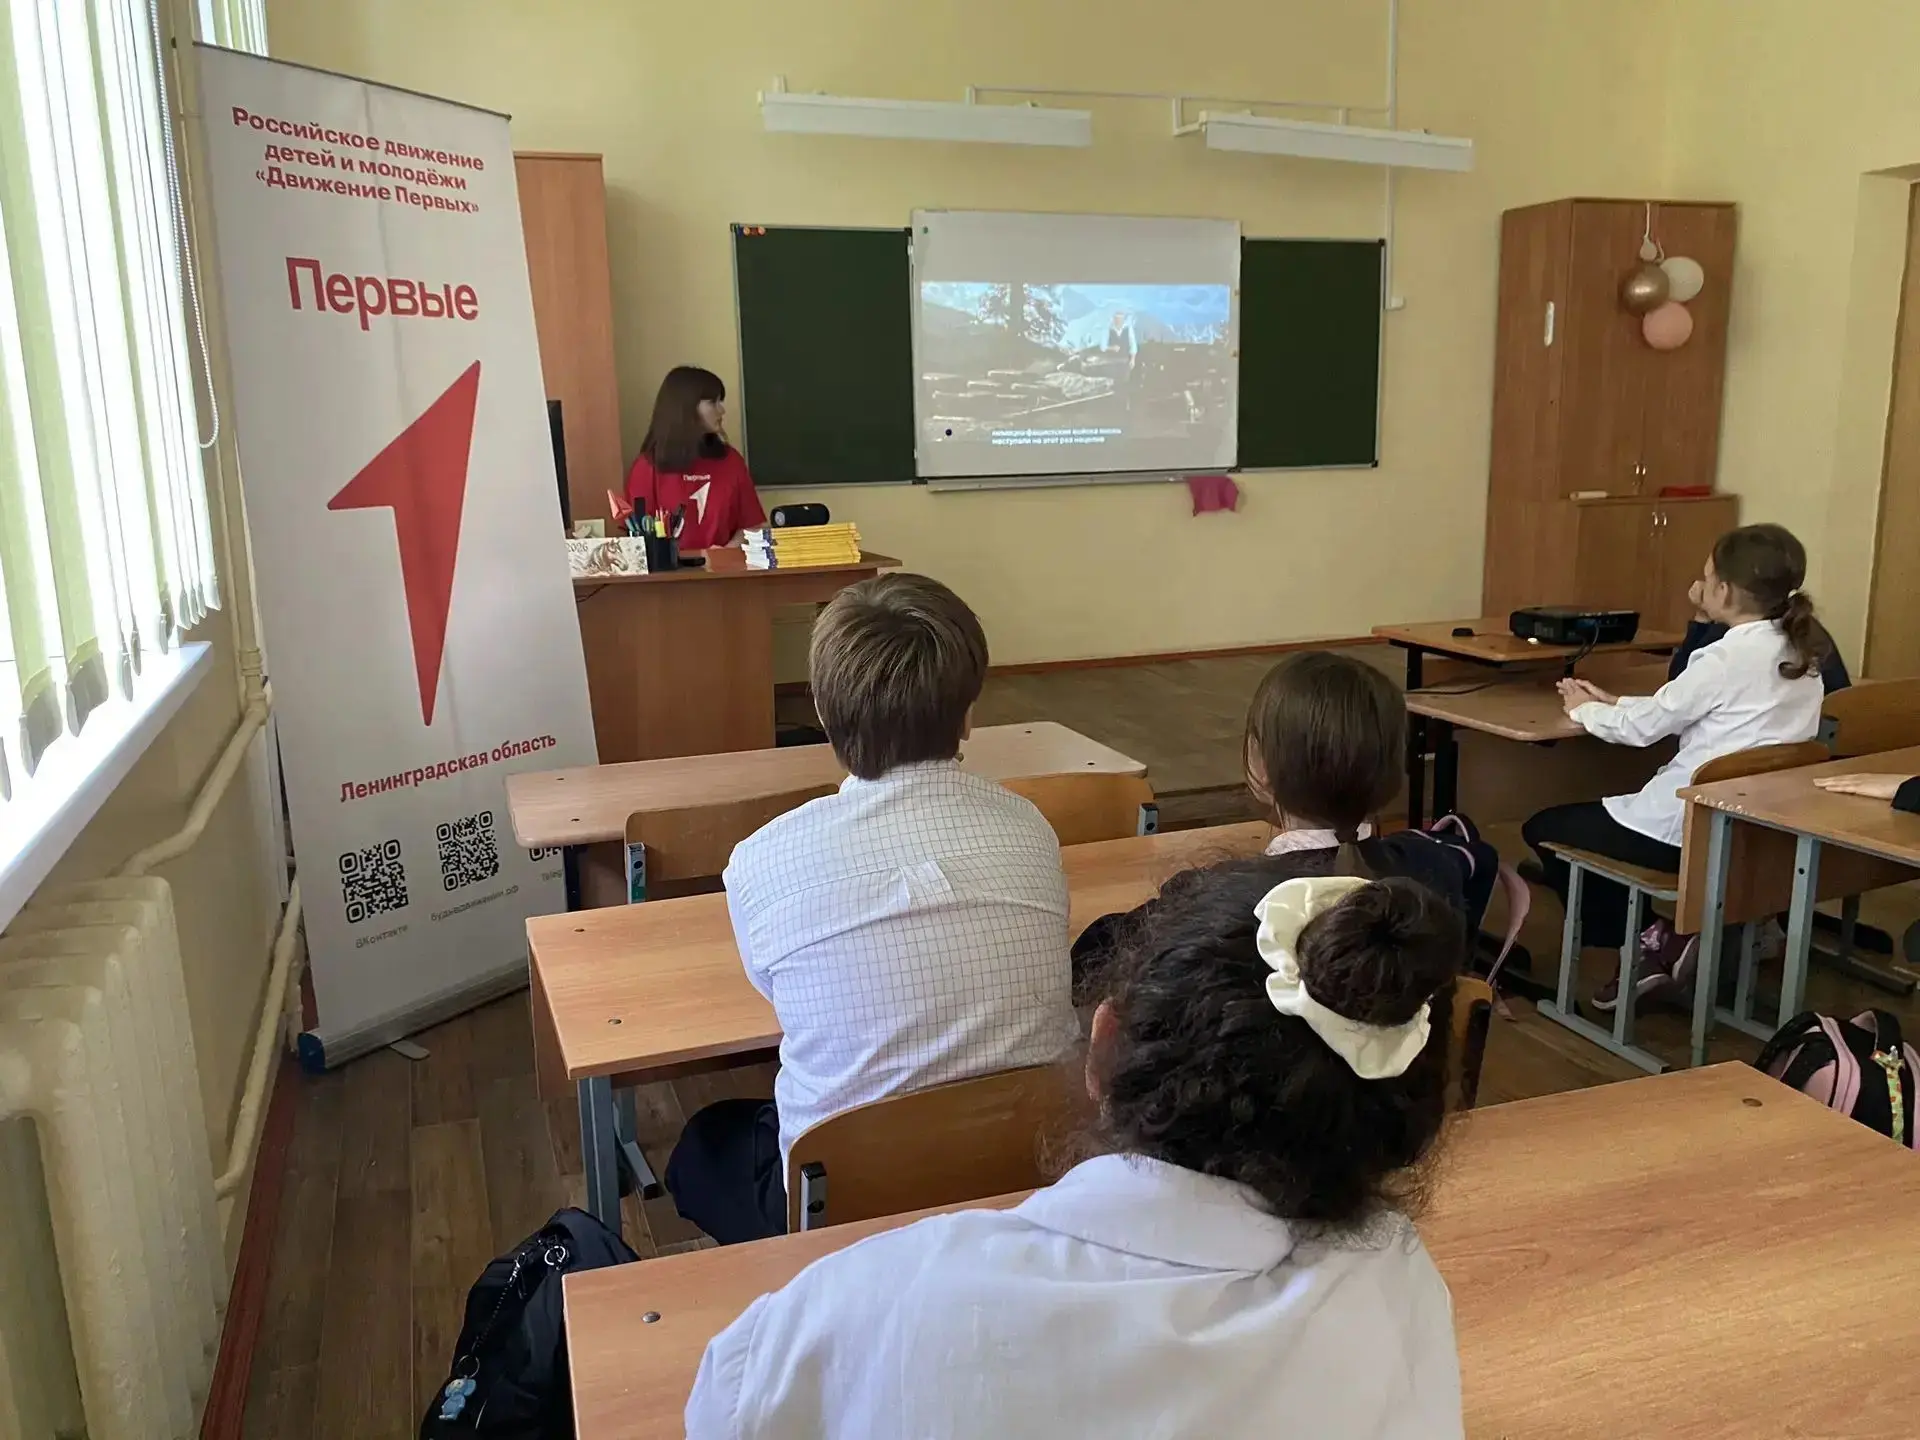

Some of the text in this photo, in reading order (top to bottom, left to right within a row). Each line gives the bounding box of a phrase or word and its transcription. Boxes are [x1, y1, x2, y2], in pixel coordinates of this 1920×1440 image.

[232, 106, 484, 171] Российское движение
[265, 144, 467, 190] детей и молодёжи
[256, 166, 479, 213] «Движение Первых»
[286, 257, 479, 331] Первые
[340, 733, 557, 802] Ленинградская область
